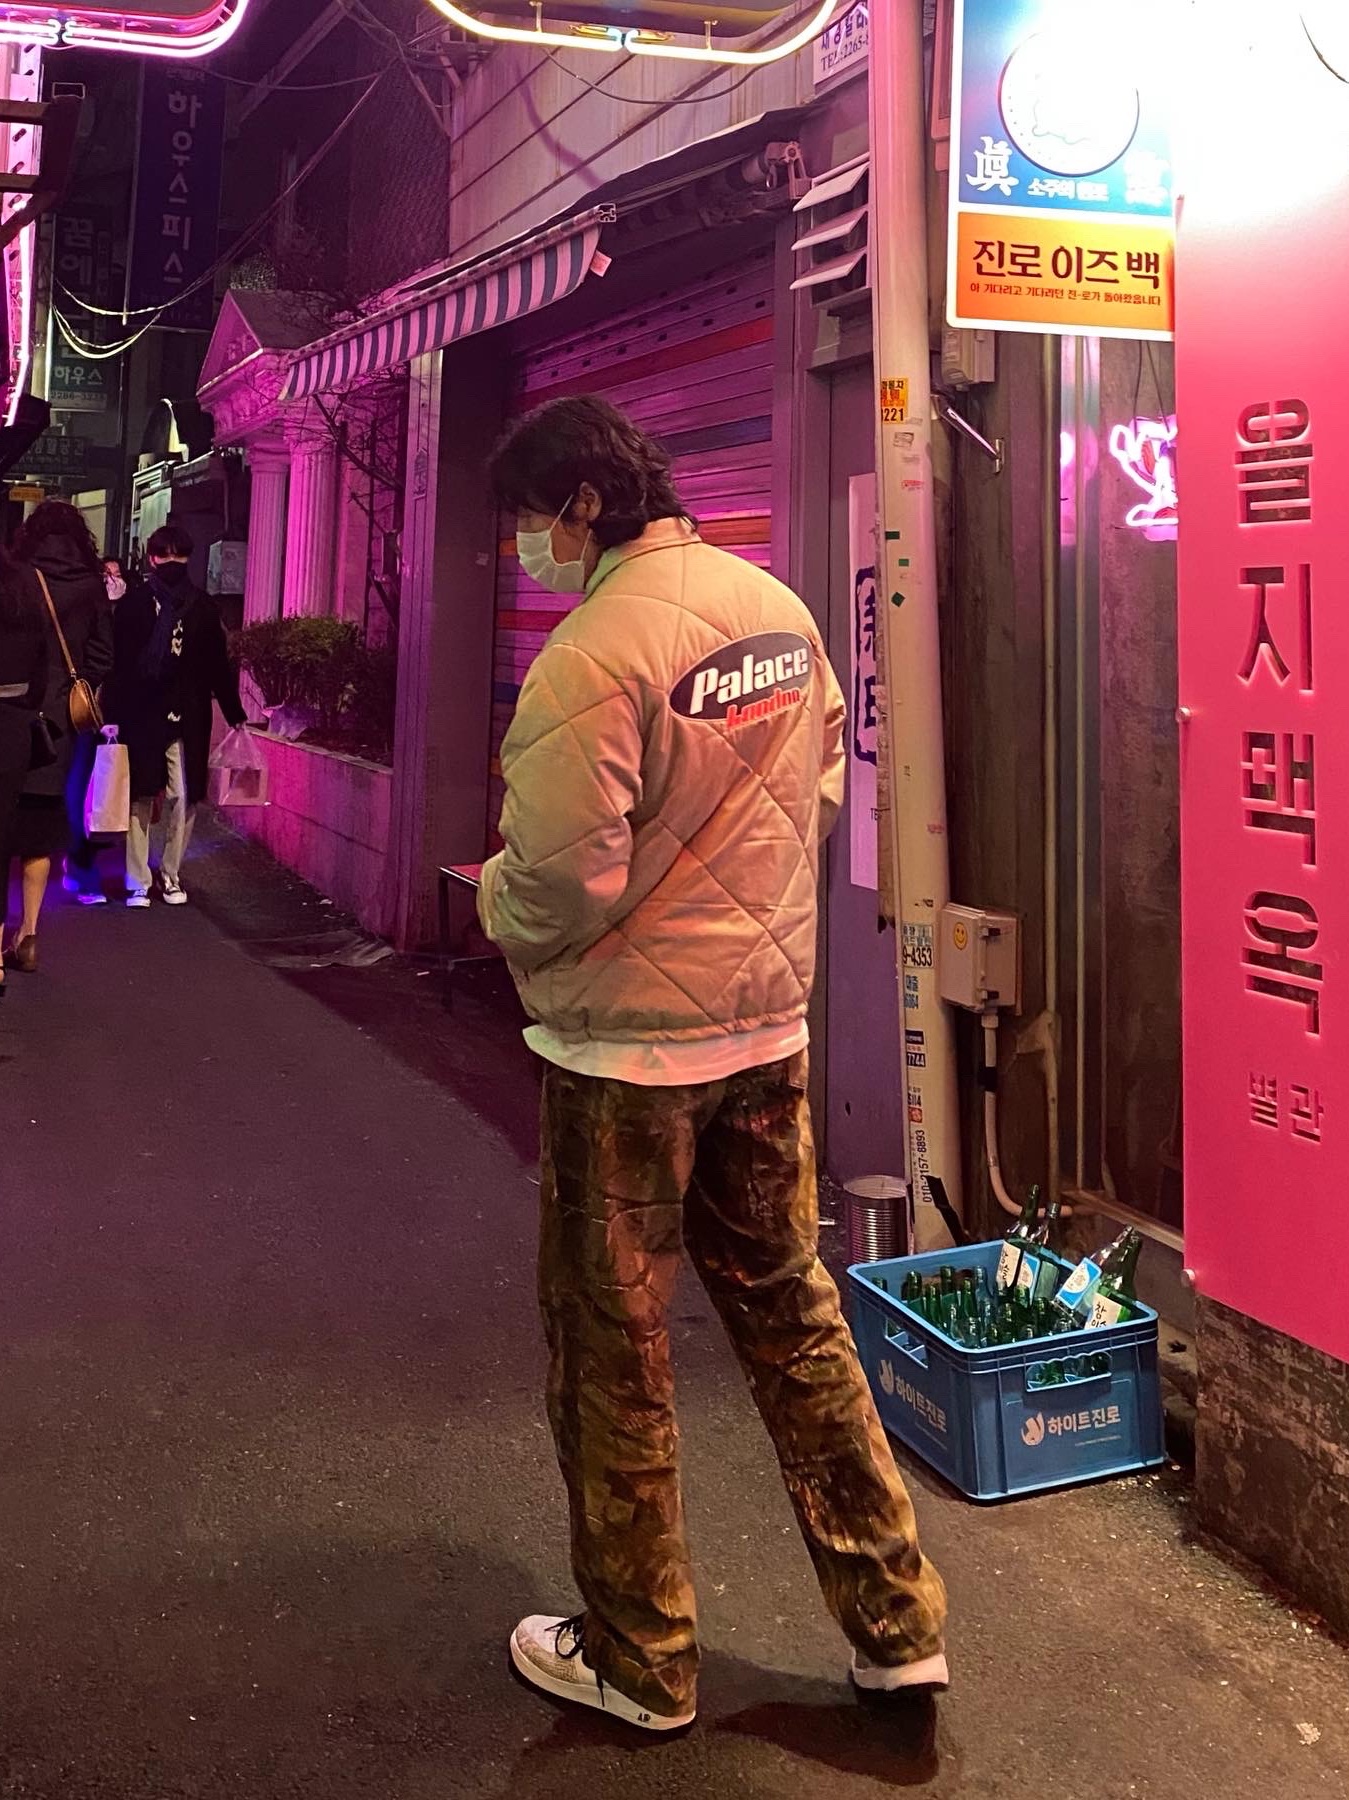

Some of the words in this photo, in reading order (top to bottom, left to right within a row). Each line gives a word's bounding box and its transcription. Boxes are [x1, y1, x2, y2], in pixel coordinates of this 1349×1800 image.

[162, 91, 202, 284] 하우스피스
[973, 240, 1042, 278] 진로
[1052, 245, 1120, 284] 이즈
[1126, 252, 1160, 290] 백
[984, 283, 1022, 296] 기다리고
[1026, 286, 1065, 300] 기다리던
[54, 365, 103, 386] 하우스
[689, 648, 808, 715] Palace
[1248, 1071, 1324, 1144] 별관
[895, 1374, 947, 1433] 하이트진로
[1047, 1404, 1121, 1436] 하이트진로
